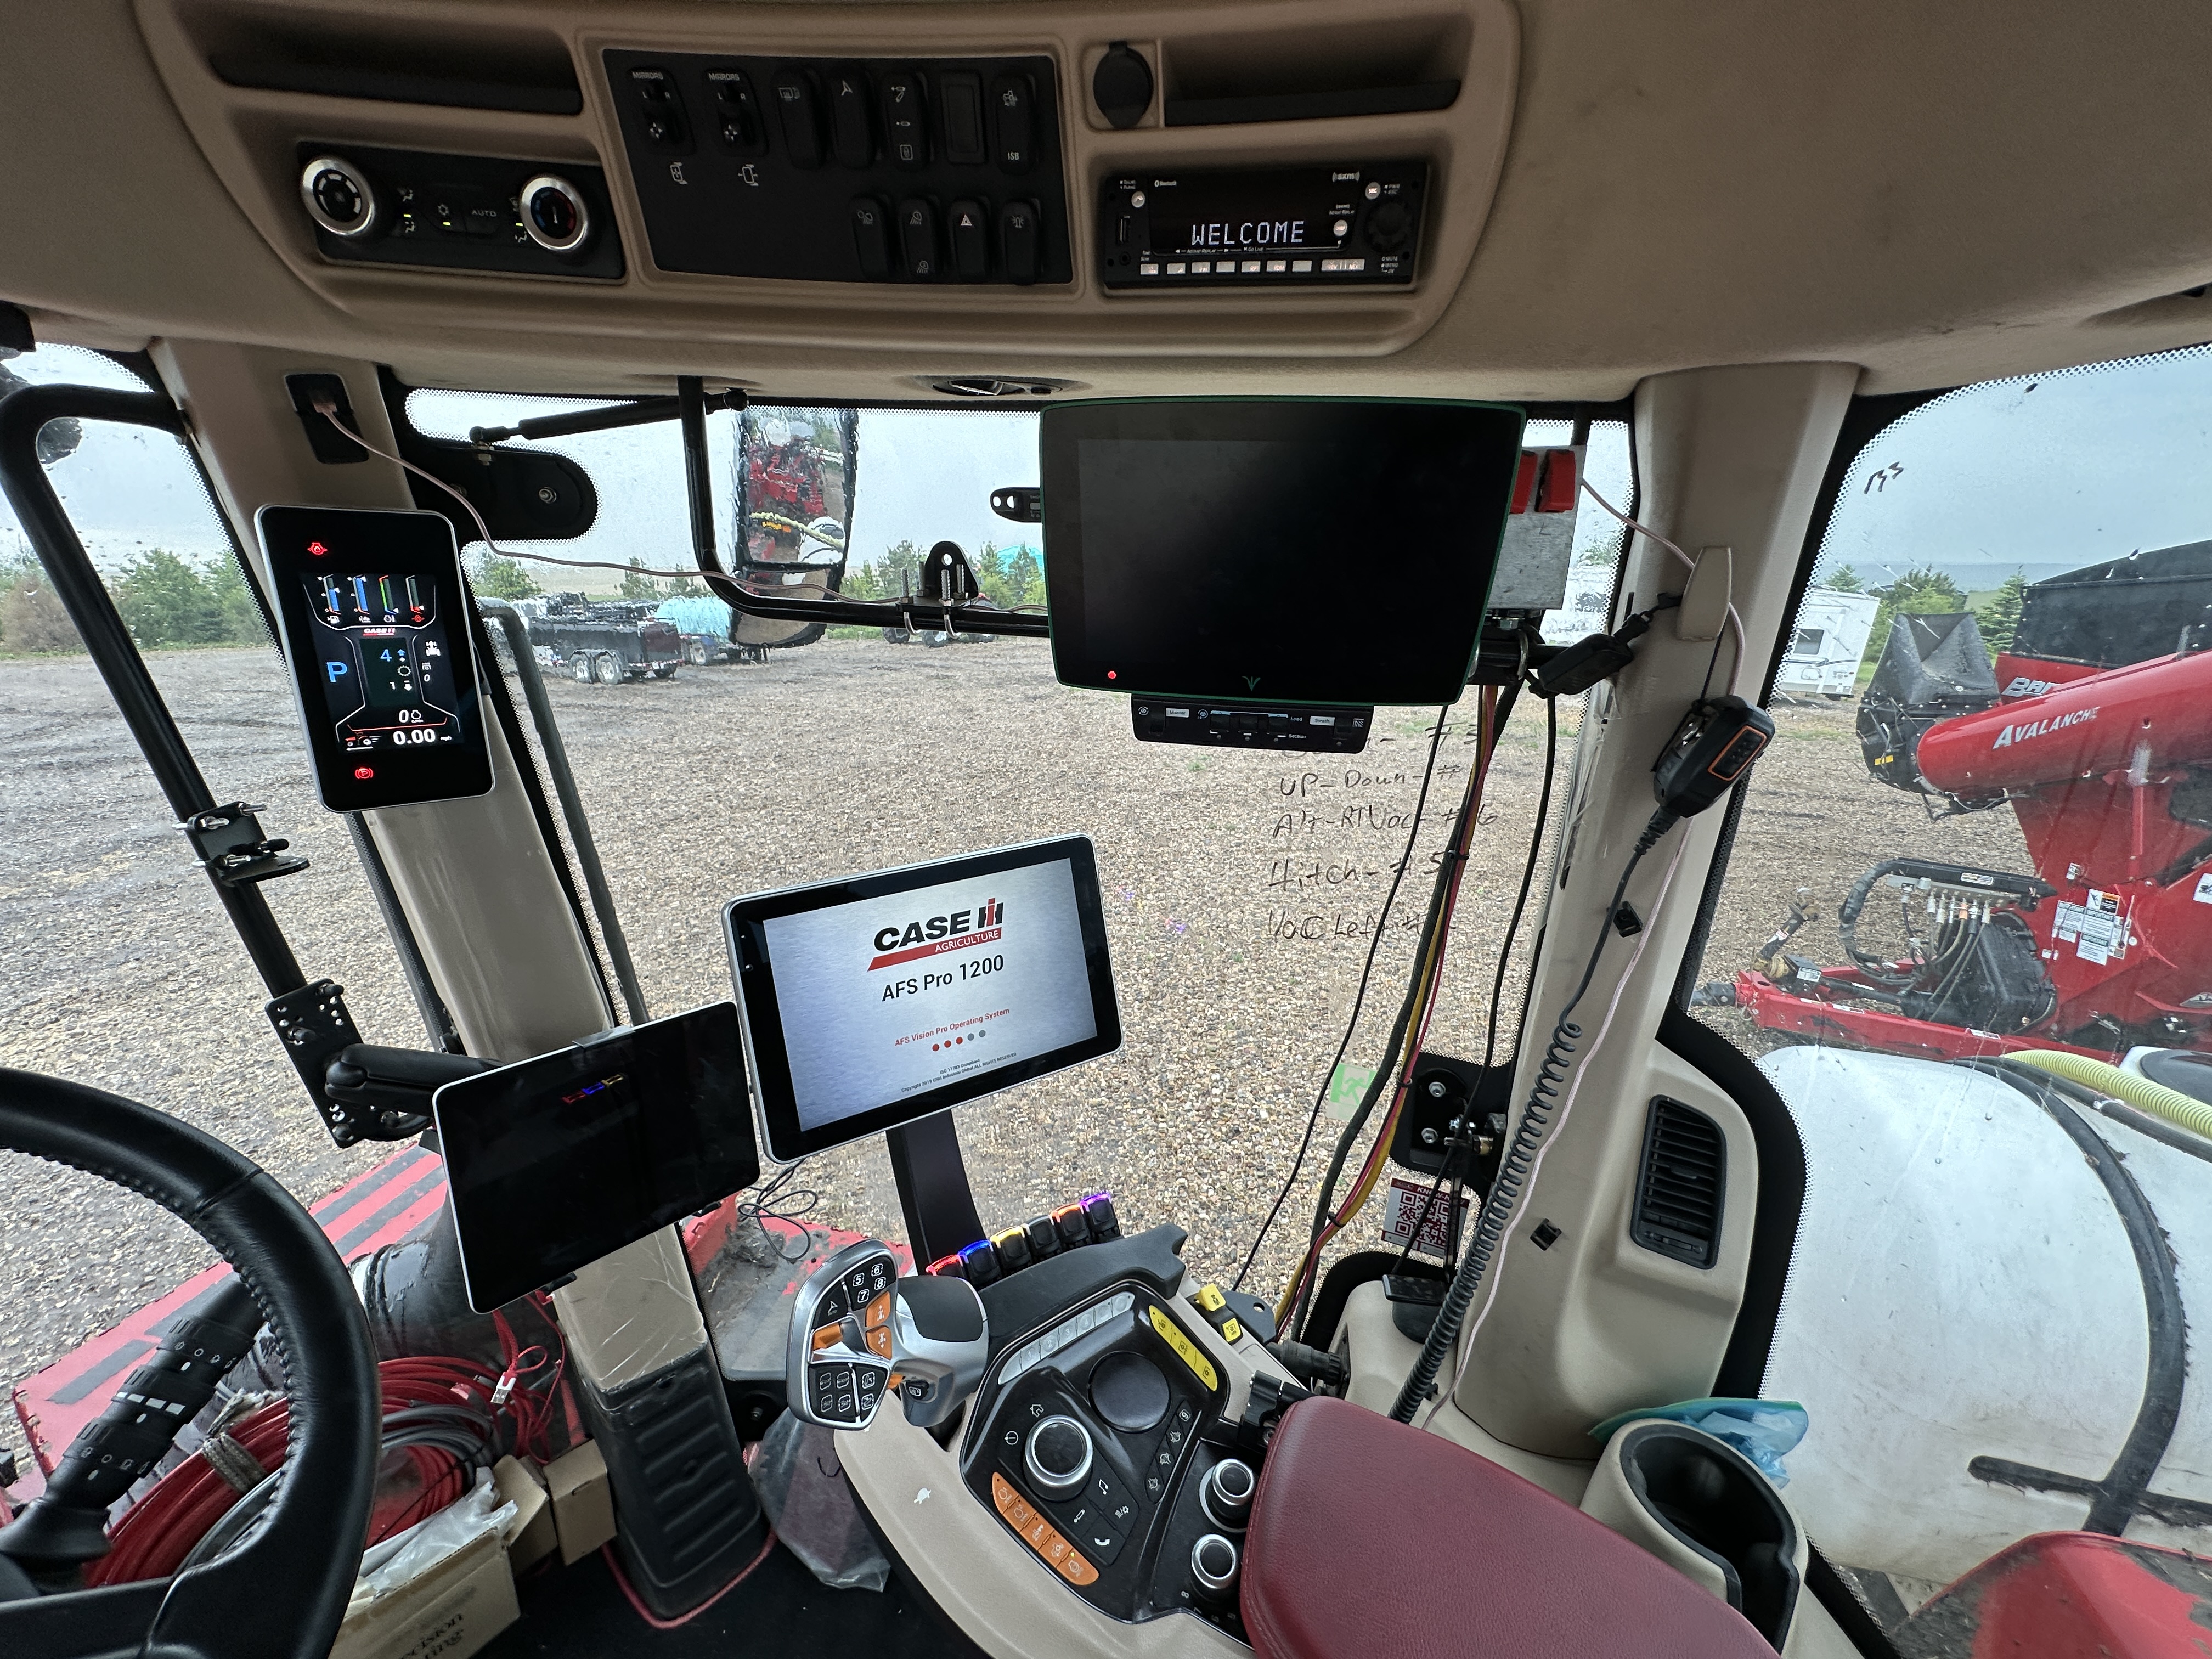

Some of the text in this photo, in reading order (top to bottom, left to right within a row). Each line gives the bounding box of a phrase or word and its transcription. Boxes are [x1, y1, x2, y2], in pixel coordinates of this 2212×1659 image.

[1008, 152, 1019, 160] ISB
[1192, 221, 1304, 245] WELCOME
[380, 649, 392, 662] 4
[326, 662, 348, 682] P
[390, 681, 396, 690] 1
[399, 709, 409, 723] 0
[393, 729, 436, 745] 0.00
[874, 910, 971, 951] CASE
[934, 930, 1000, 952] AGRICULTURE
[882, 955, 1004, 1002] AFS Pro 1200
[895, 1036, 910, 1047] AFS
[911, 1030, 934, 1041] Vision
[950, 1015, 983, 1030] Operating
[985, 1008, 1009, 1021] System
[961, 1059, 980, 1068] Compliant
[901, 1083, 921, 1092] Copyright
[943, 1070, 961, 1080] Industrial
[997, 1052, 1017, 1062] RESERVED
[874, 1265, 881, 1274] 6
[855, 1275, 862, 1284] 5
[877, 1279, 884, 1288] 8
[861, 1291, 867, 1301] 7
[1048, 1340, 1053, 1348] 2
